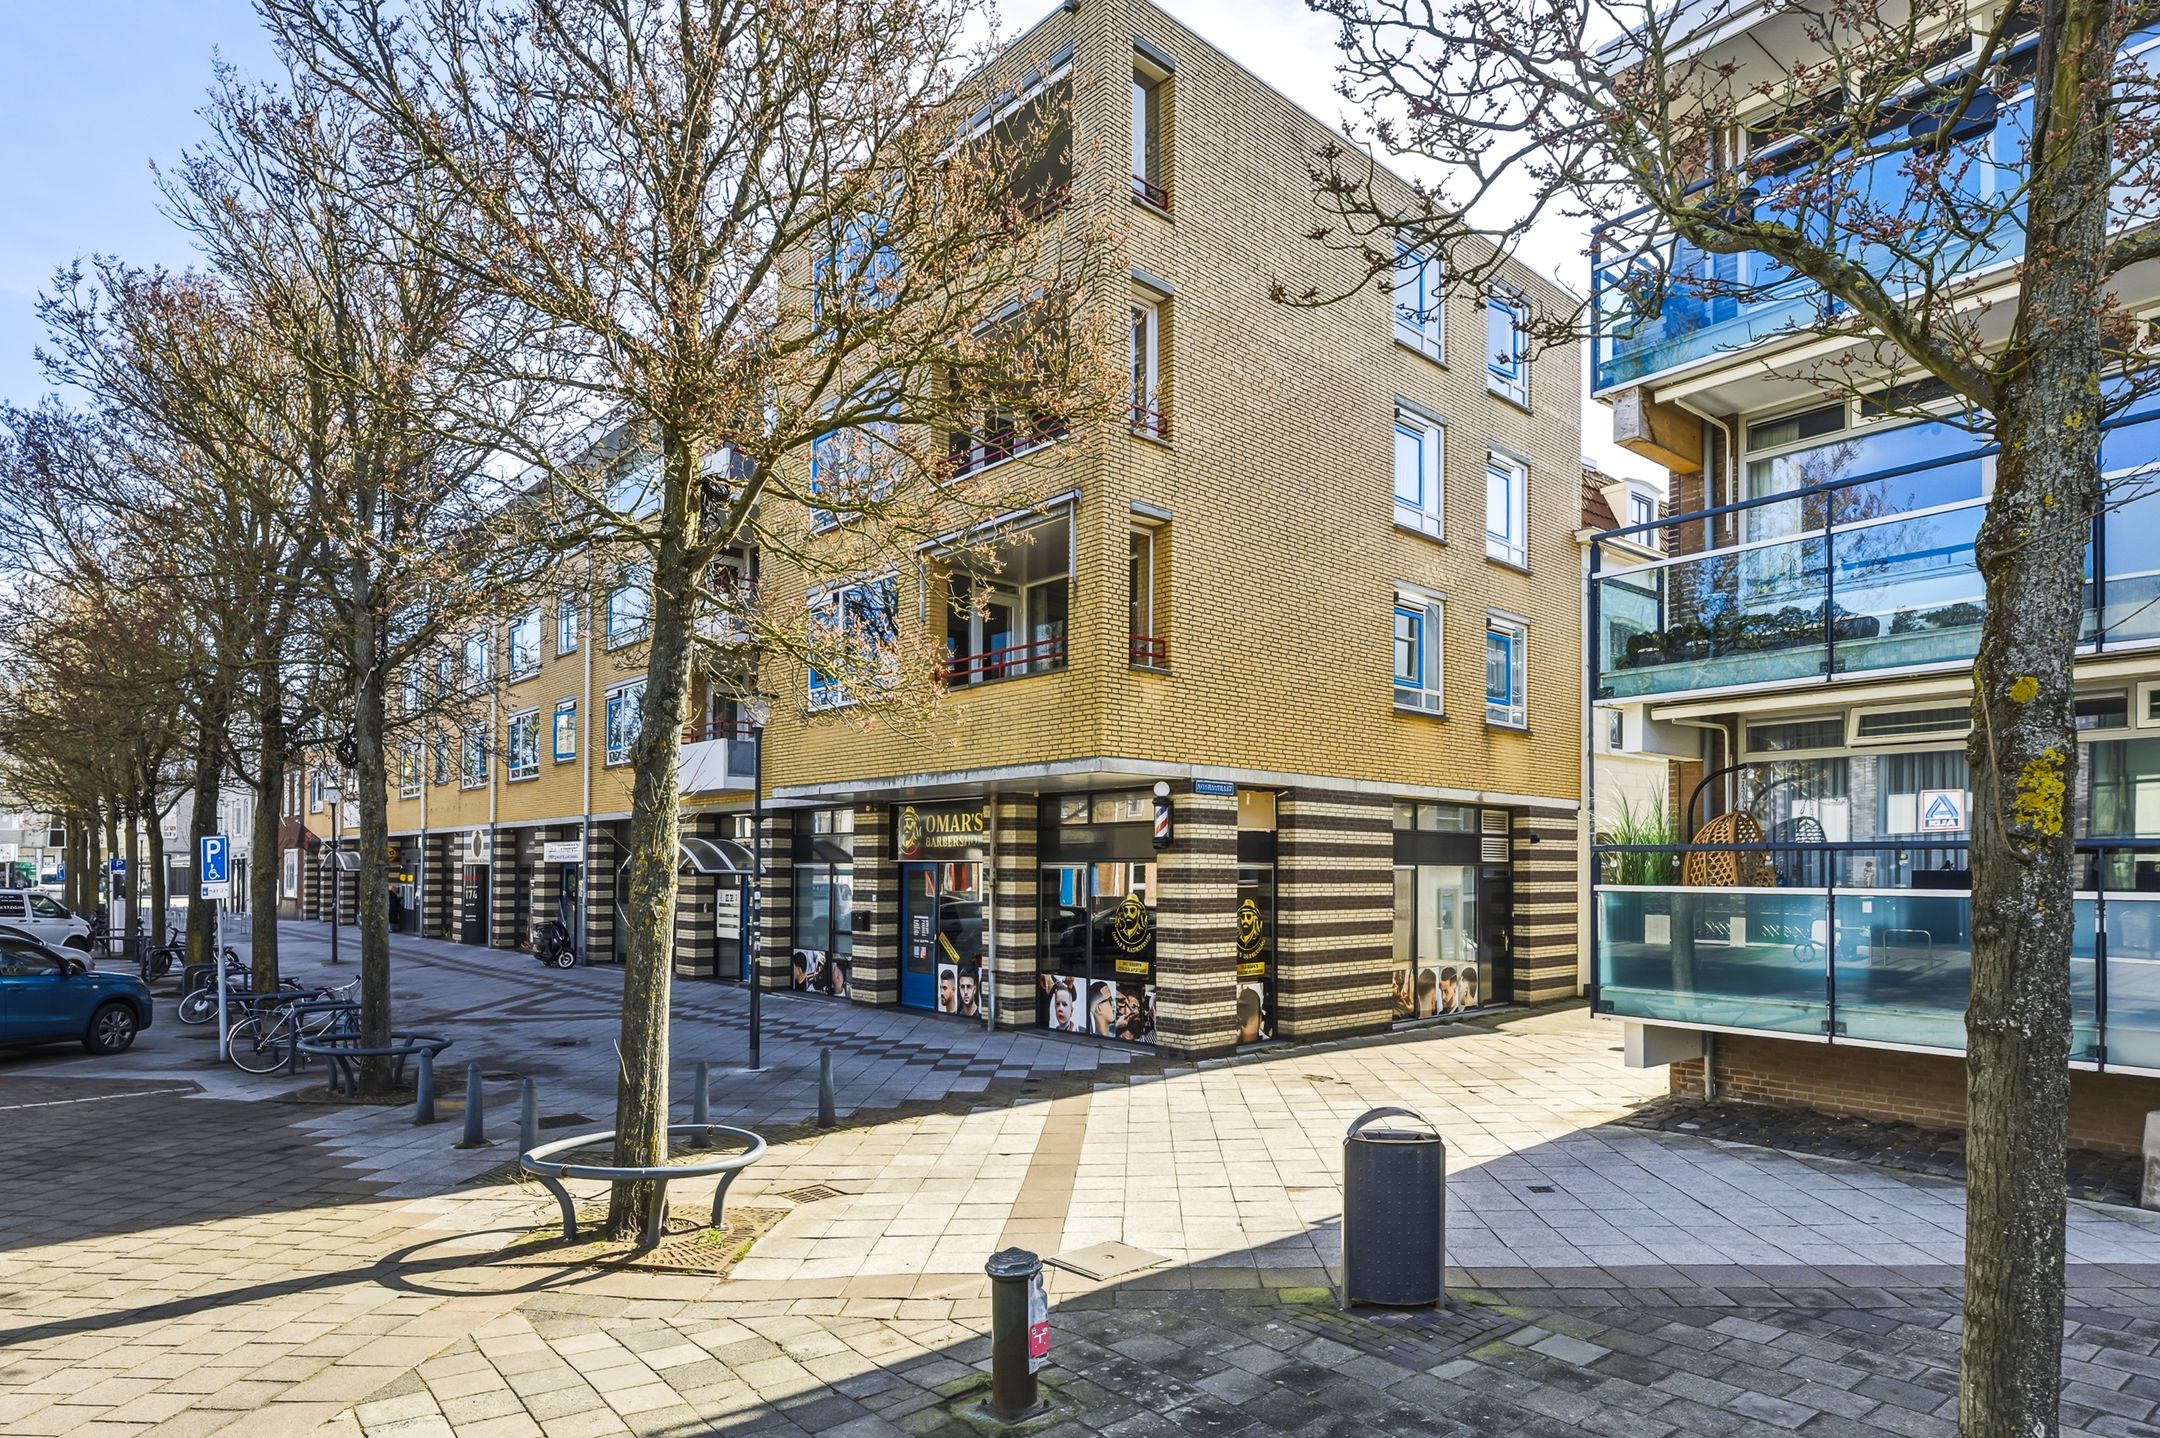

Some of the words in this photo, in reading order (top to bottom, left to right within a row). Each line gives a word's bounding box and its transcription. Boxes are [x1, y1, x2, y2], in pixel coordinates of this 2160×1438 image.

[926, 812, 983, 833] OMAR'S
[206, 840, 221, 863] P
[925, 835, 983, 848] BARBERSHO
